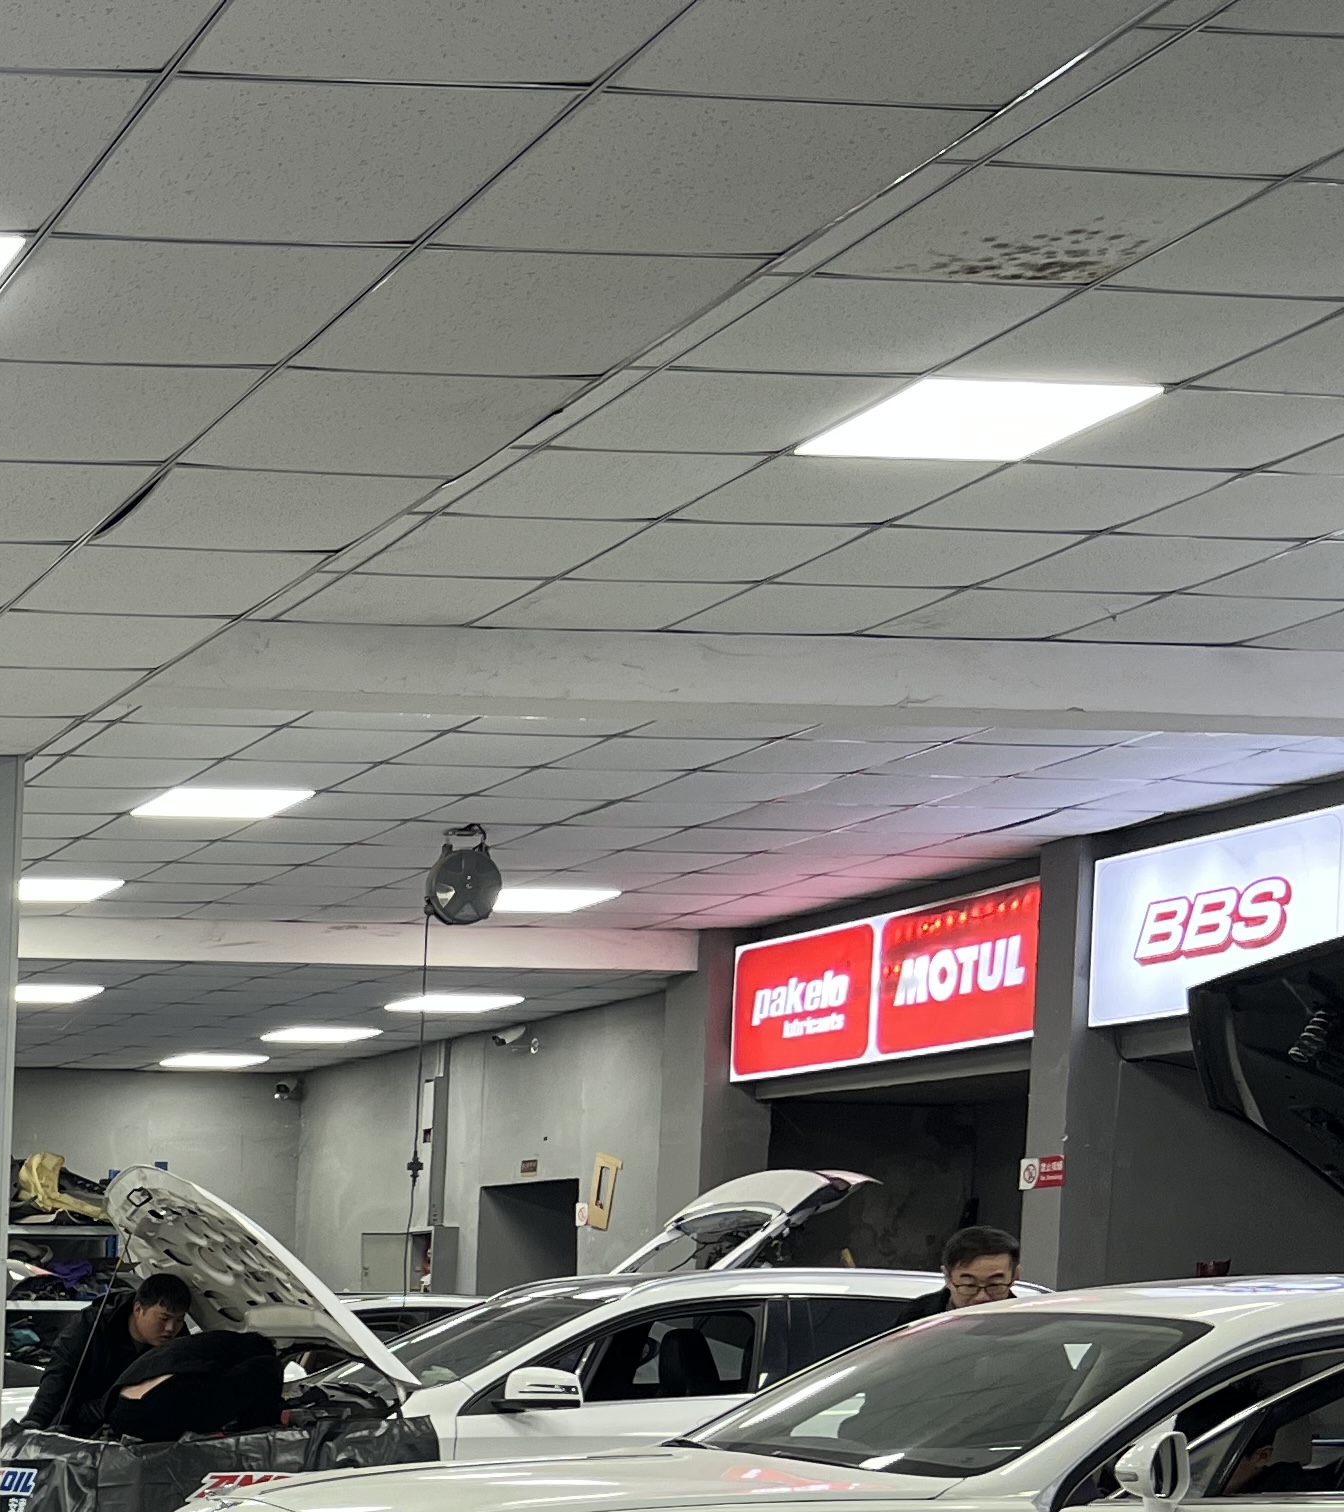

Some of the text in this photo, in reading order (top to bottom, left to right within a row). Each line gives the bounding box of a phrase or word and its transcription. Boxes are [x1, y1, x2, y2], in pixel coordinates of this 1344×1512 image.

[1134, 876, 1292, 967] BBS
[751, 970, 850, 1026] pakelo
[893, 934, 1026, 1006] MOTUL
[782, 1012, 845, 1038] lubricants
[0, 1470, 34, 1493] OIL
